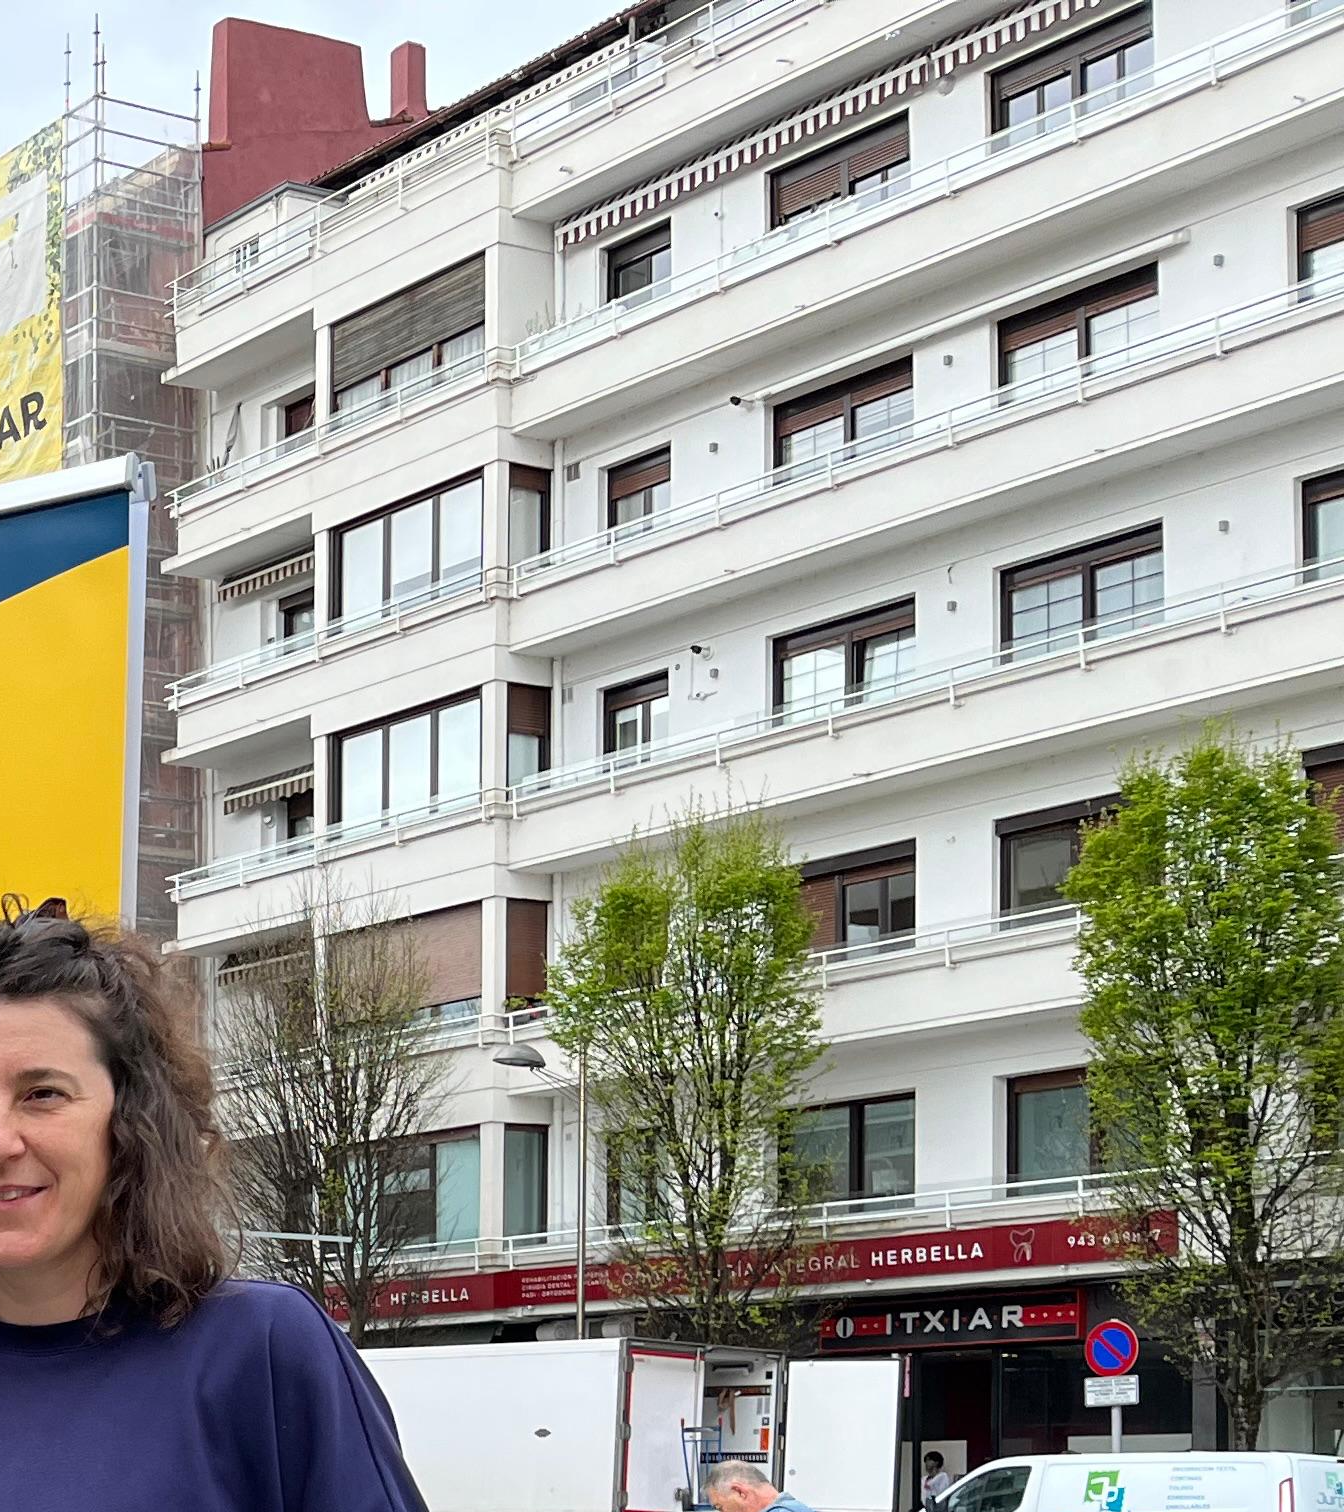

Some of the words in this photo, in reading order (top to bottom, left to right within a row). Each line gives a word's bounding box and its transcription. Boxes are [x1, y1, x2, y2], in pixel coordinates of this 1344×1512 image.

[871, 1242, 984, 1267] HERBELLA
[1067, 1233, 1096, 1248] 943
[885, 1304, 1025, 1336] ITXIAR
